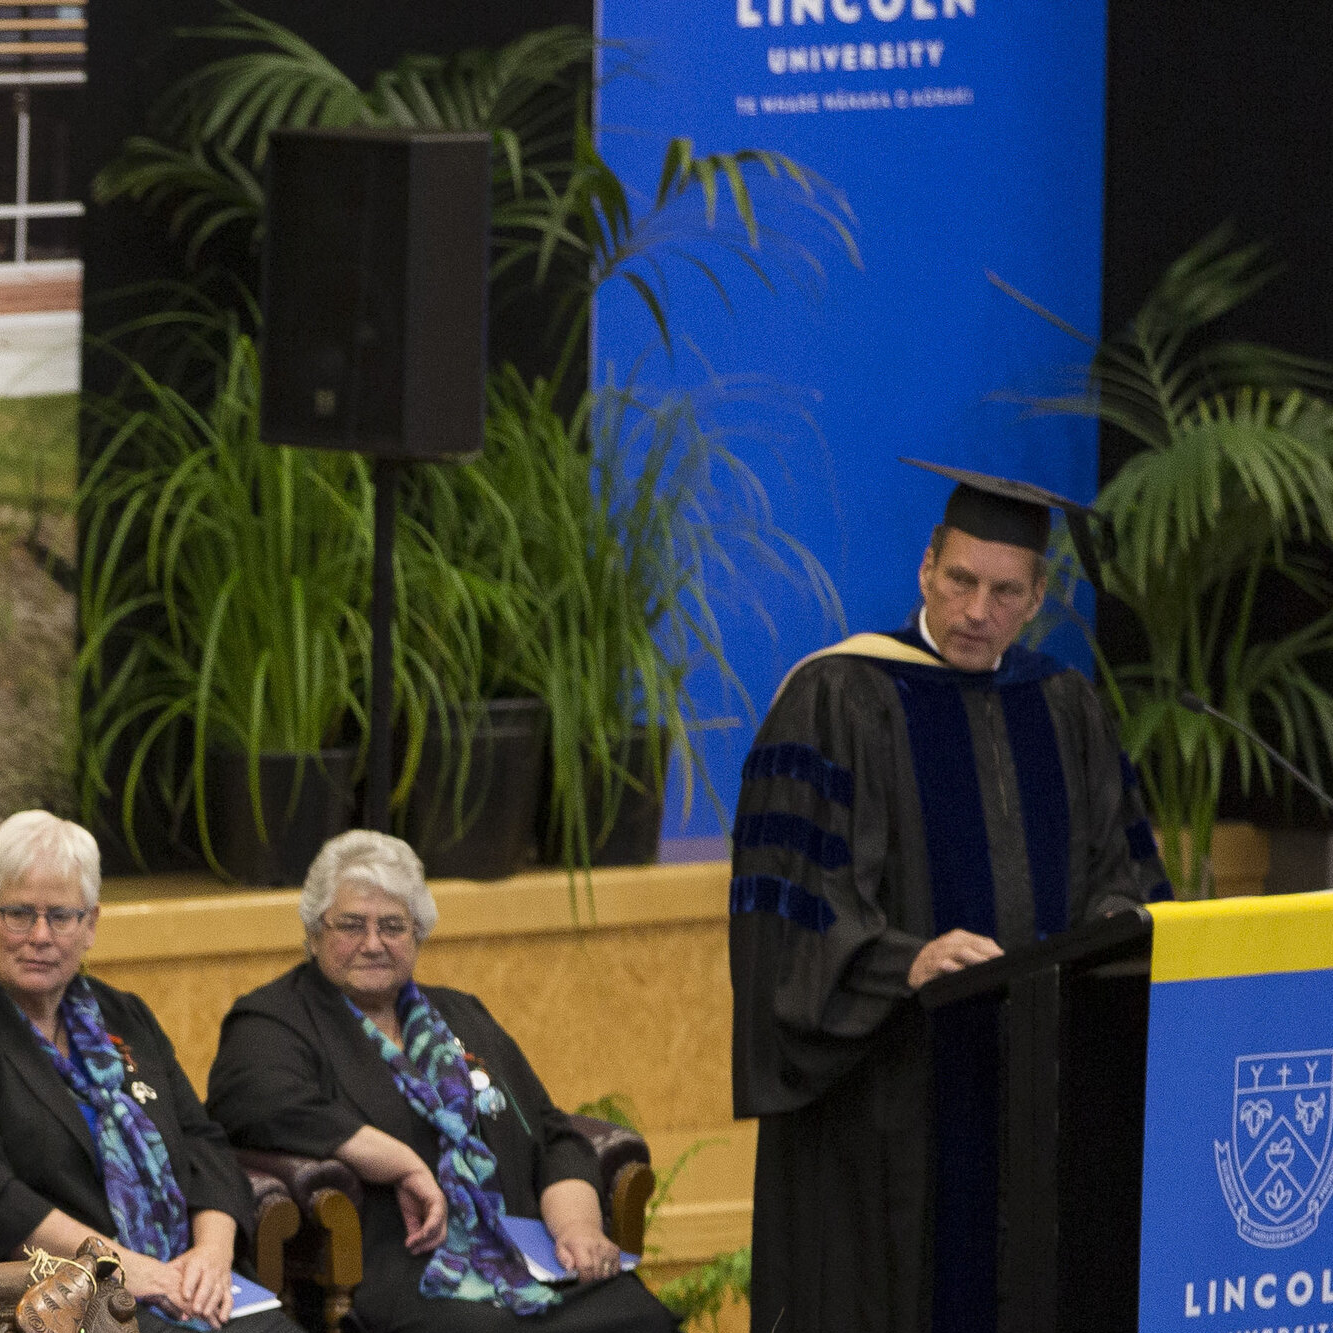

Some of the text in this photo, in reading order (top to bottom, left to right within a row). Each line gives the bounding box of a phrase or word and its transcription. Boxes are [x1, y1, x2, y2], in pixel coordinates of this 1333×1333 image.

[736, 0, 975, 28] LINCOLN
[767, 40, 944, 75] UNIVERSITY
[1184, 1268, 1333, 1318] LINCOL
